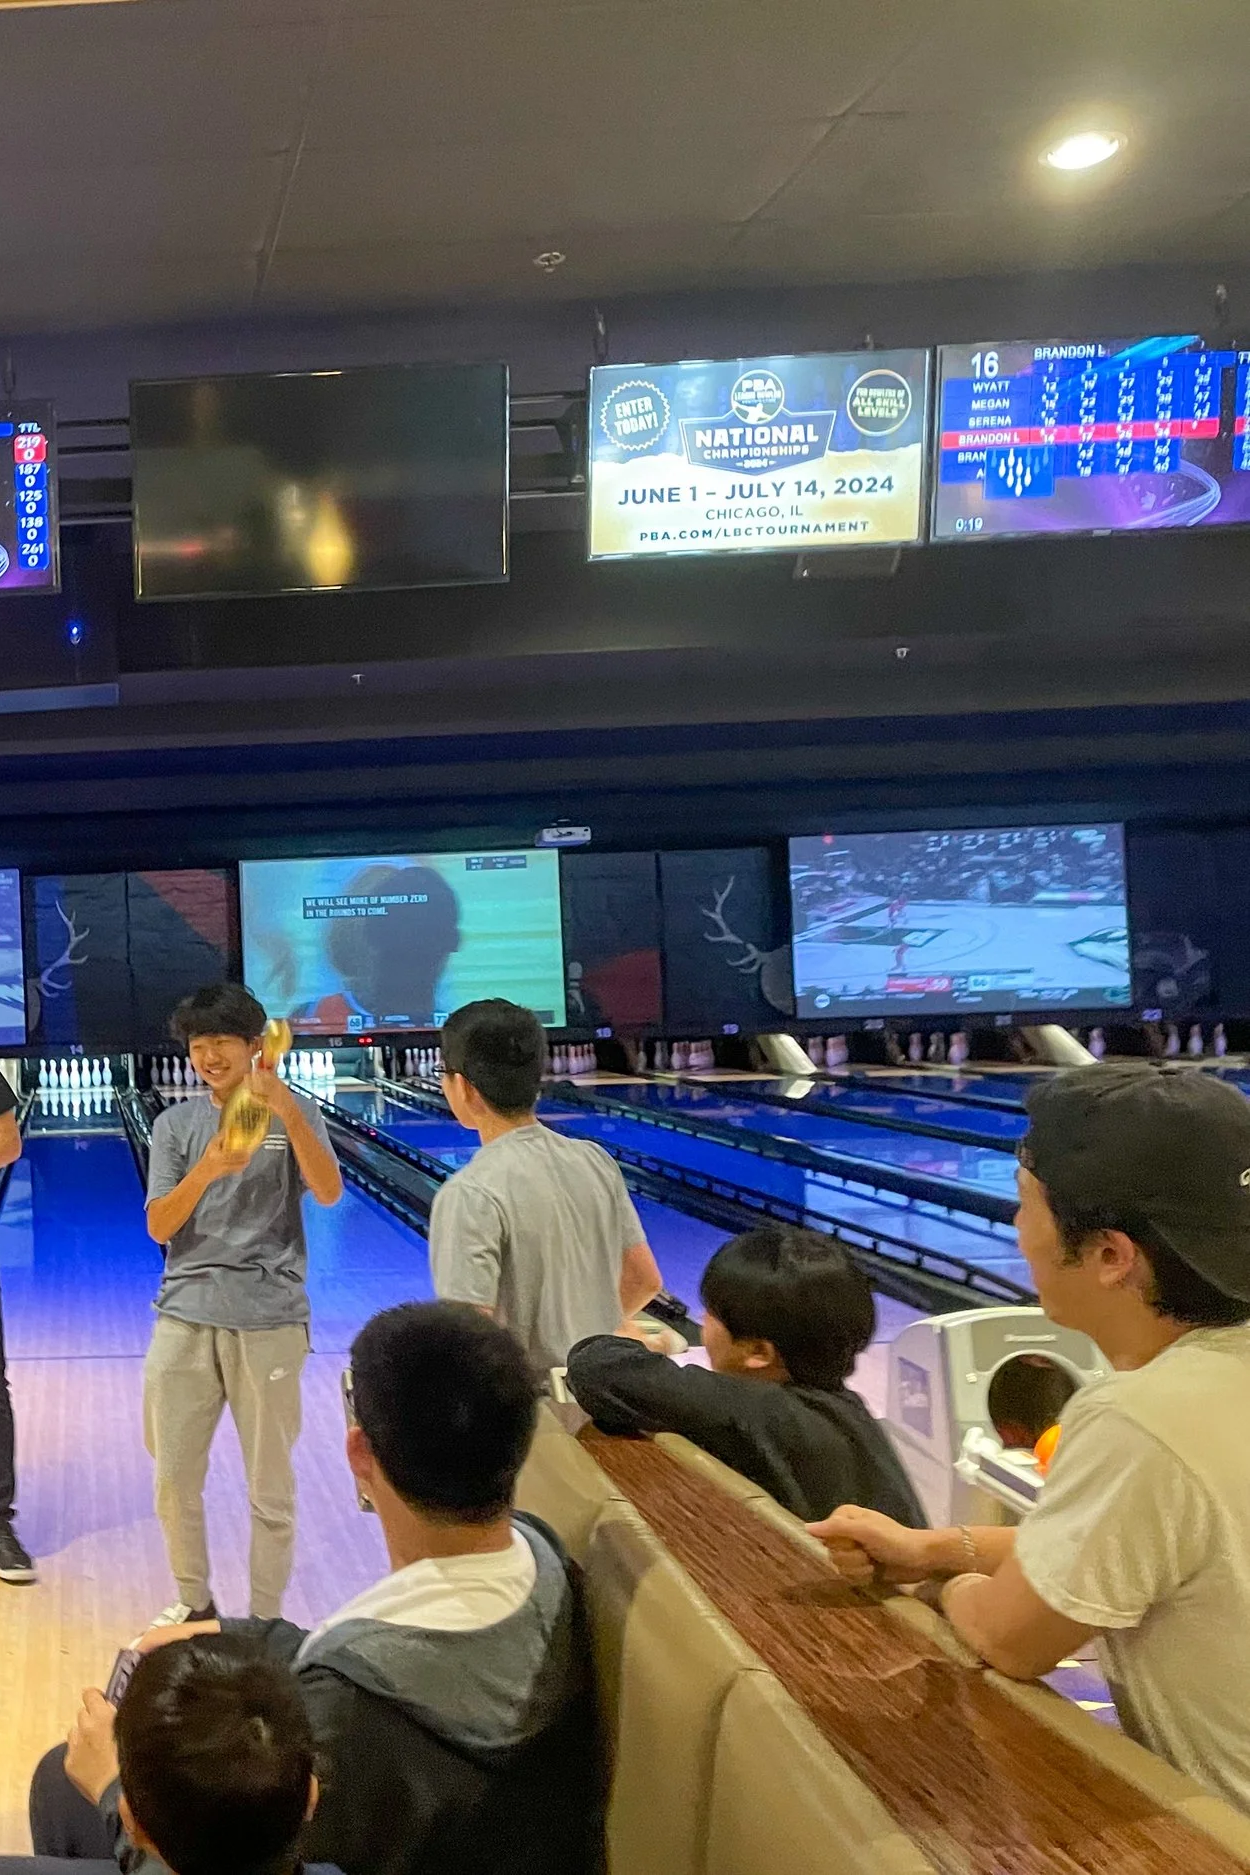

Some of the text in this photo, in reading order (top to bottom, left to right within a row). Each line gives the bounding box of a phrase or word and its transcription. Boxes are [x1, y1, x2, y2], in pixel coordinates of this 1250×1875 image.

[1034, 344, 1106, 360] BRANDON L
[971, 351, 999, 379] 16
[741, 378, 777, 392] PBA
[972, 380, 1011, 393] WYATT
[614, 396, 653, 419] ENTER
[852, 397, 905, 409] ALL SKILL
[971, 398, 1010, 411] MEGAN
[857, 407, 899, 418] LEVELS
[17, 422, 42, 433] TTL
[614, 411, 659, 436] TODAY!
[968, 415, 1012, 429] SERENA
[16, 436, 41, 449] 219
[695, 424, 819, 448] NATIONAL
[958, 431, 1020, 446] BRANDON L
[23, 449, 35, 460] 0
[703, 444, 810, 460] CHAMPIONSHIPS
[18, 463, 42, 475] 187
[24, 475, 36, 487] 0
[18, 490, 43, 502] 125
[618, 487, 681, 506] JUNE
[689, 486, 698, 502] 1
[725, 481, 786, 500] JULY
[795, 479, 826, 499] 14,
[833, 475, 894, 495] 2024
[25, 501, 37, 514] 0
[706, 505, 803, 521] CHICAGO, IL
[20, 516, 43, 529] 138
[955, 517, 983, 532] 0:19
[26, 528, 38, 540] 0
[639, 520, 870, 541] PBA.COM/LBCTOURNAMENT
[21, 543, 44, 555] 261
[27, 554, 39, 567] 0
[305, 894, 428, 907] WE WILL SEE MORE OF NUMBER ZERO
[306, 909, 314, 917] IN
[315, 909, 327, 917] THE
[330, 908, 356, 917] ROUNDS
[357, 908, 366, 916] TO
[349, 1018, 362, 1028] 68
